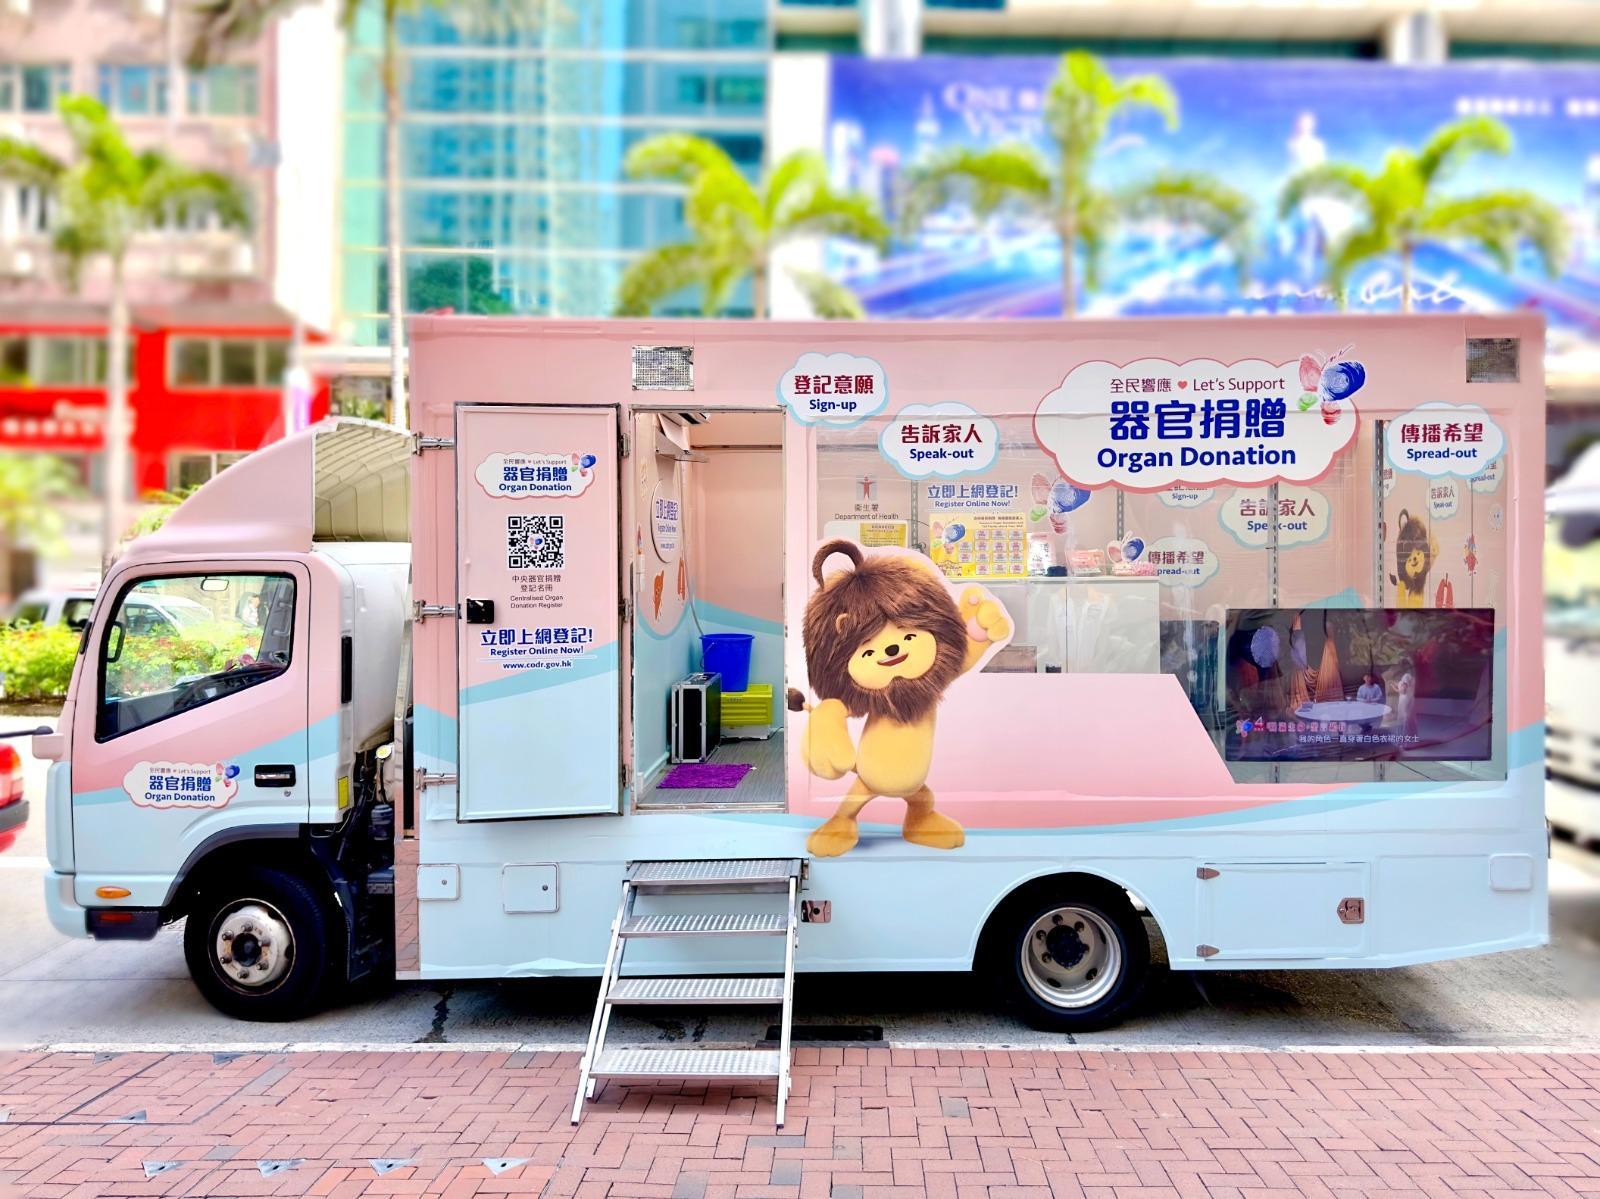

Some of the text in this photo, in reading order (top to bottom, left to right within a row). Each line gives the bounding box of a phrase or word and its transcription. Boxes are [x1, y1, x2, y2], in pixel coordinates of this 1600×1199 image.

[794, 375, 874, 395] 登記意願
[1110, 378, 1172, 393] 全民響應
[1229, 377, 1286, 393] Support
[809, 398, 857, 412] Sign-up
[1109, 397, 1287, 441] 器官捐贈
[901, 423, 983, 443] 告訴家人
[1401, 422, 1483, 443] 傳播希望
[909, 447, 974, 462] Speak-out
[1097, 443, 1296, 473] Organ Donation
[1406, 447, 1478, 462] Spread-out
[503, 466, 568, 482] 器官捐贈
[499, 482, 572, 493] Organ Donation
[927, 484, 1019, 499] 立即上網登記!
[1171, 492, 1199, 501] Sign-up
[935, 501, 964, 509] Register
[1247, 520, 1308, 533] Spek-out
[1147, 550, 1205, 565] 傳播希望
[480, 627, 593, 646] 立即上網登記!
[490, 645, 584, 657] Register Online Now!
[502, 660, 572, 670] www.codr.gov.hk
[149, 775, 212, 792] 器官捐贈
[144, 792, 216, 802] Organ Donation
